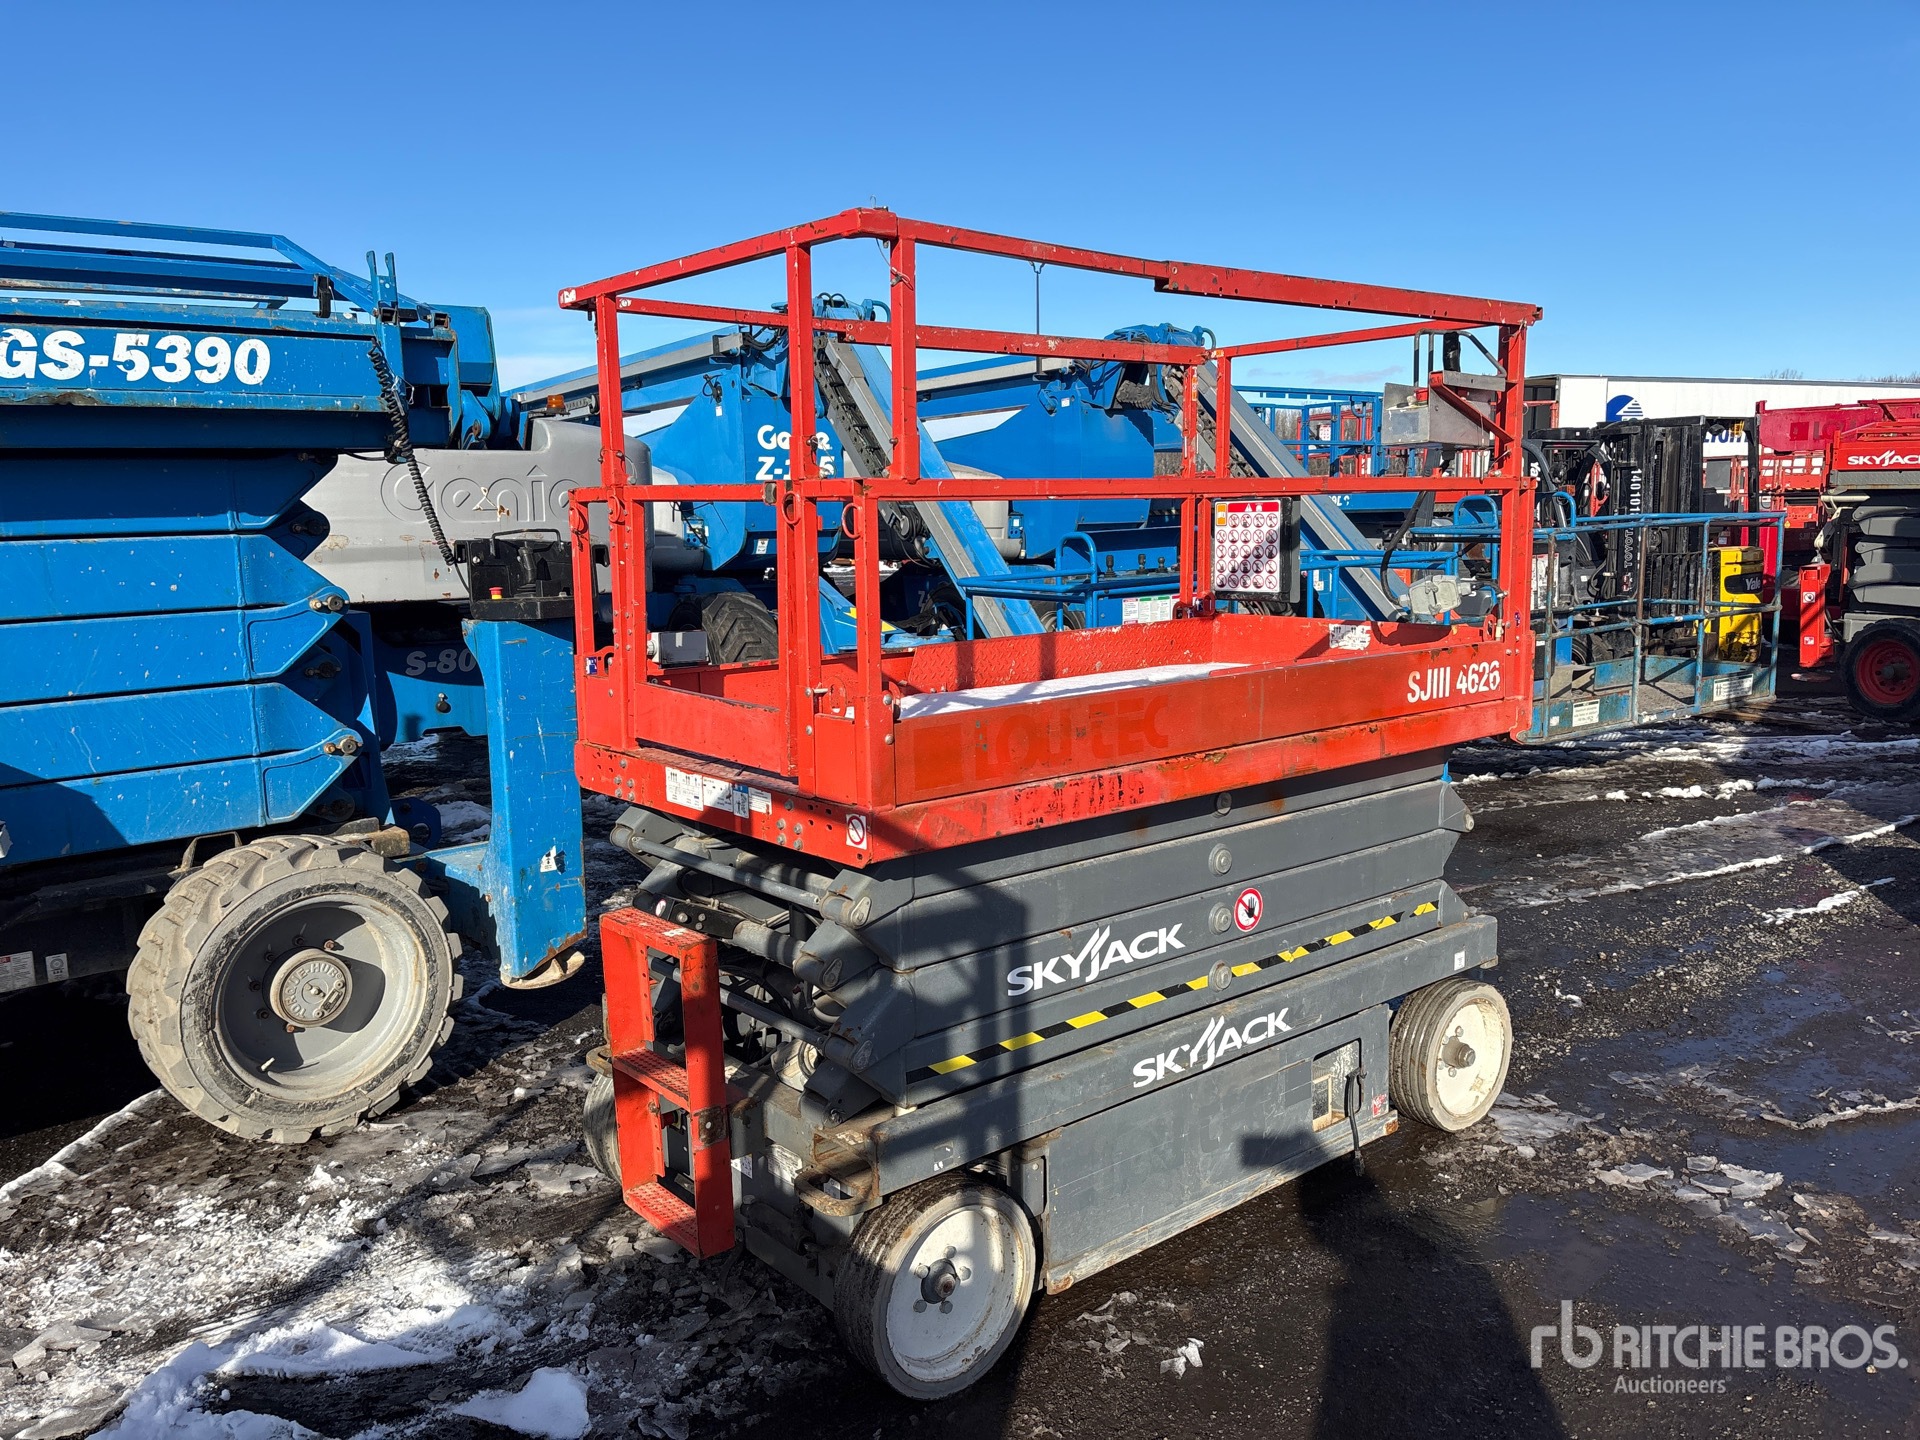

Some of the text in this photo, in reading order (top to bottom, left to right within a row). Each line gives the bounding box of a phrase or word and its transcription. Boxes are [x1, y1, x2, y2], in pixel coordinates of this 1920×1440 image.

[0, 328, 271, 385] GS-5390
[757, 424, 833, 450] Gee
[1623, 527, 1634, 569] TOYOT
[1407, 660, 1501, 703] SJIII 4626
[1007, 923, 1186, 997] SKYJACK
[1133, 1007, 1293, 1088] SKYJACK
